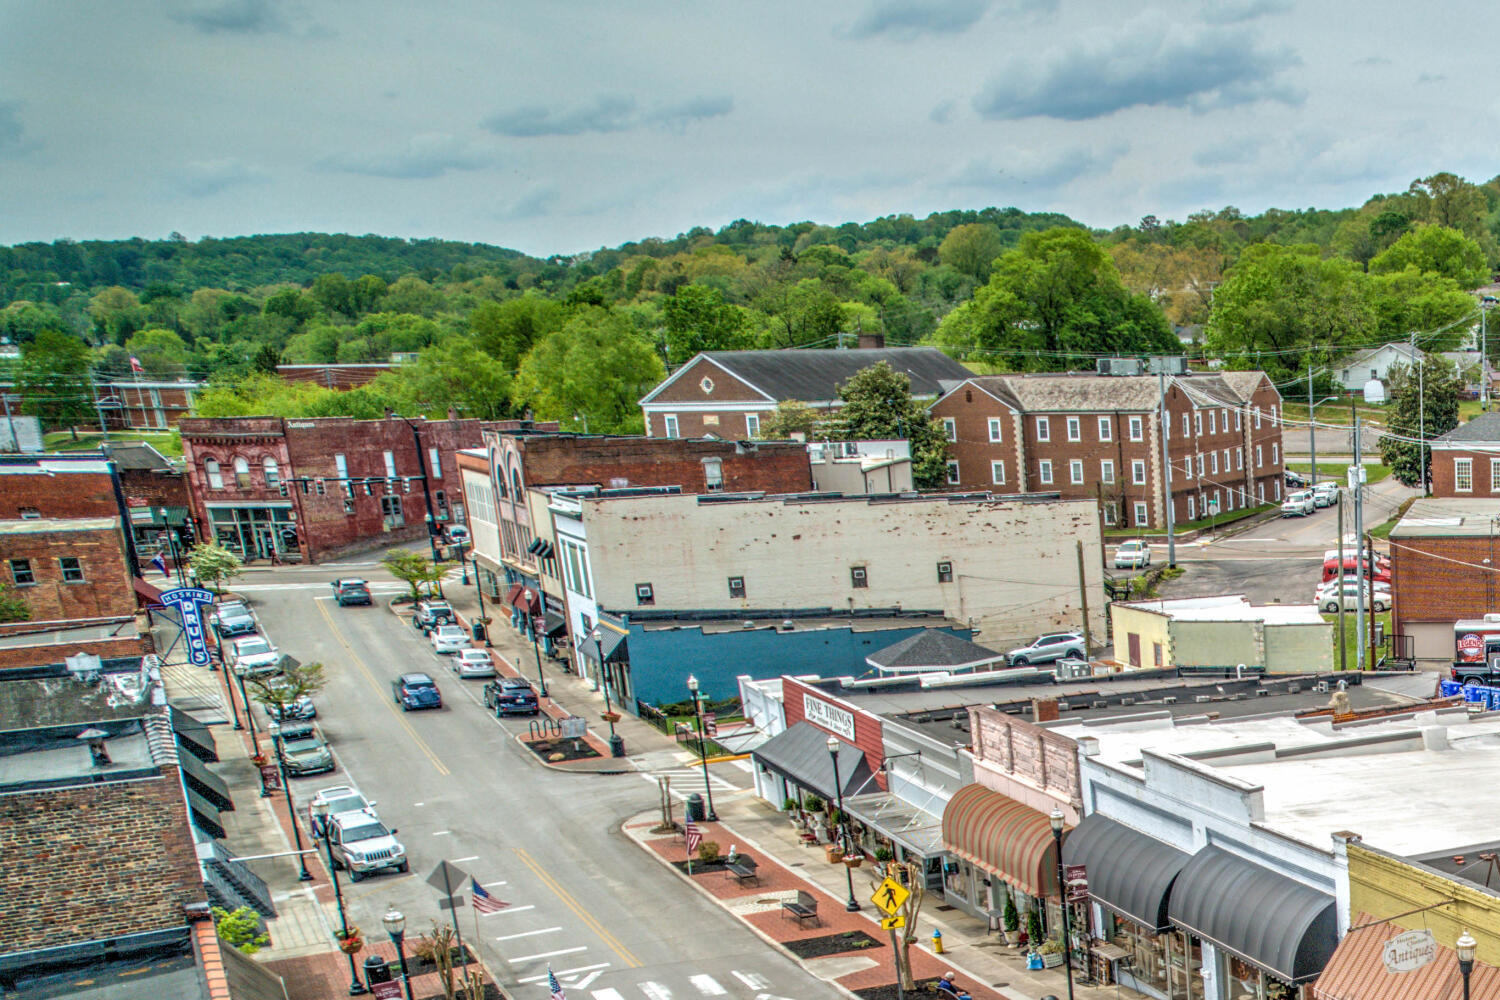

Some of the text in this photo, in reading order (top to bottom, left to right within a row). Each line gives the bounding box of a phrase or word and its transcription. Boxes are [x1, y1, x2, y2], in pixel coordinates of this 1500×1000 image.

[164, 591, 210, 602] HOSKINS
[183, 601, 206, 662] DRUGS
[805, 696, 823, 715] FINE
[823, 704, 852, 728] THINGS
[1389, 945, 1435, 964] Antiques
